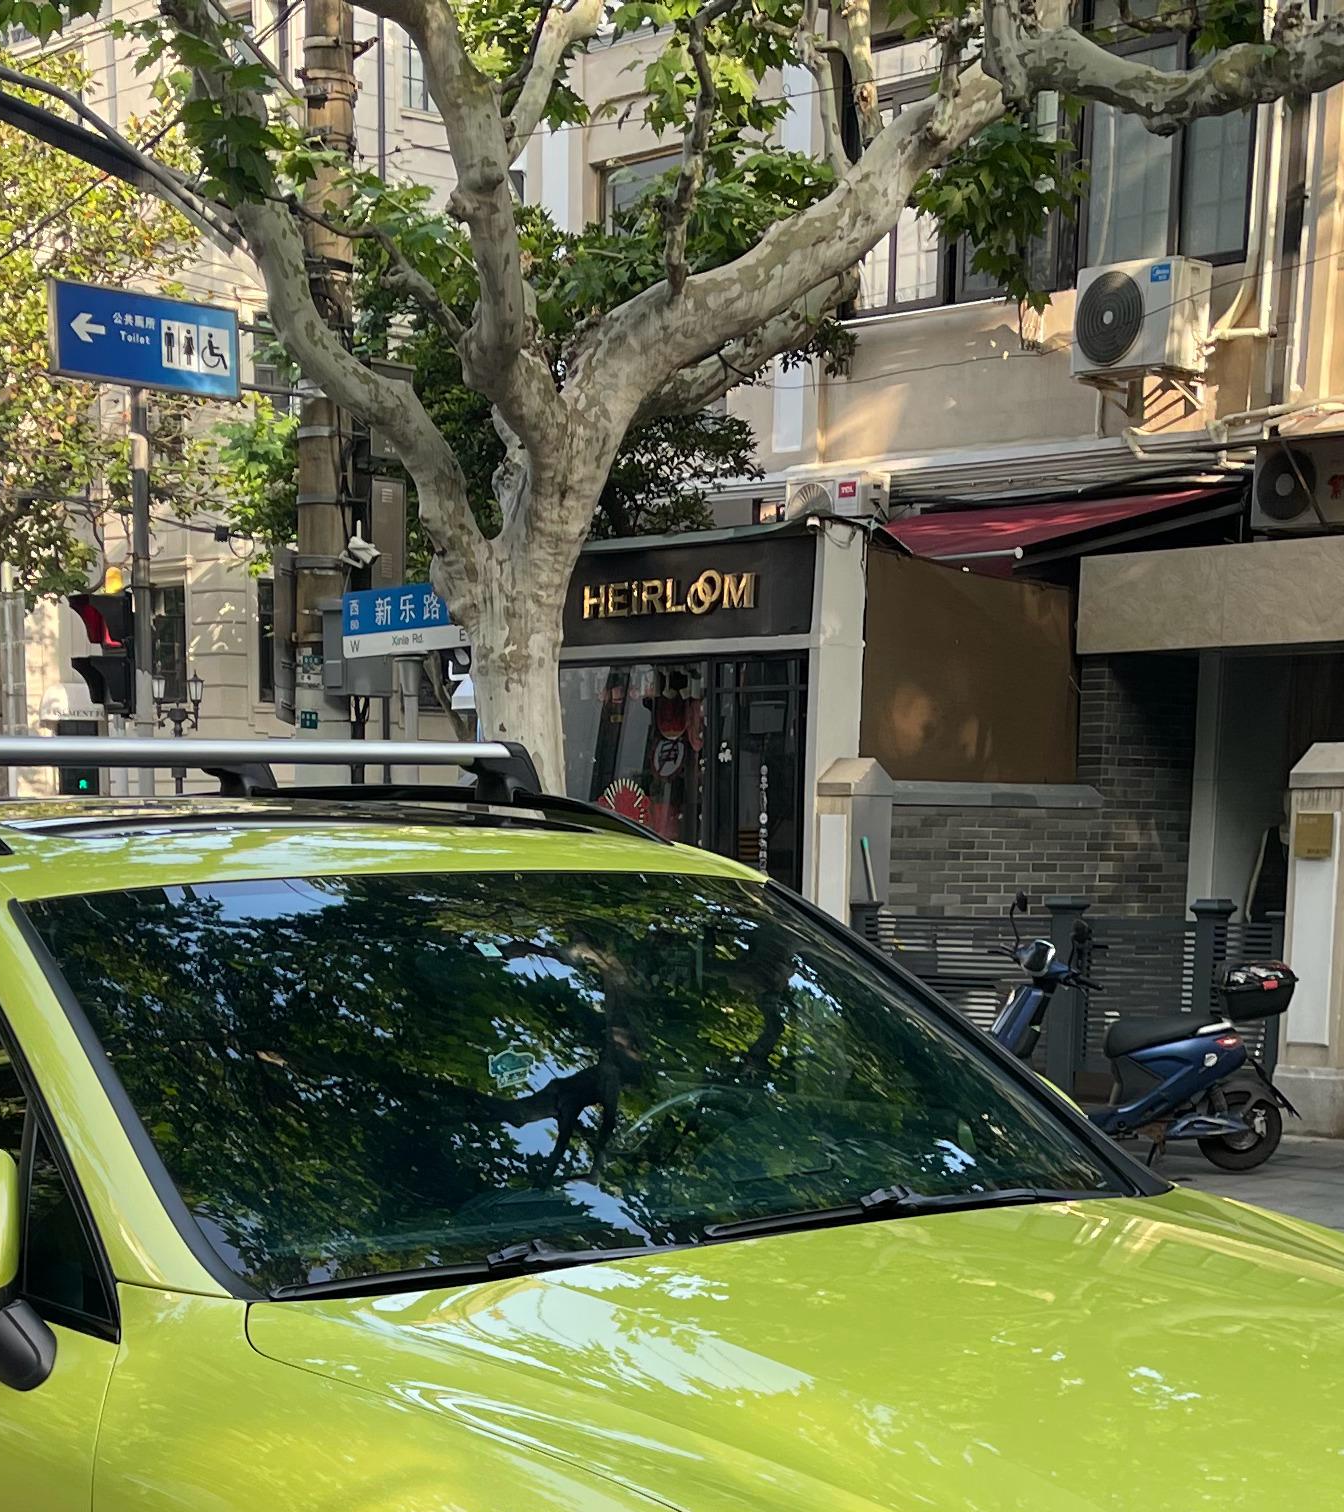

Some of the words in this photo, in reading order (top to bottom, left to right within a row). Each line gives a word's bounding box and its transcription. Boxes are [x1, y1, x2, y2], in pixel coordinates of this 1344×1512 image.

[119, 331, 151, 346] Toilet
[374, 592, 441, 626] 新乐路
[391, 636, 409, 646] Xinle
[459, 629, 466, 642] E
[350, 640, 360, 653] W
